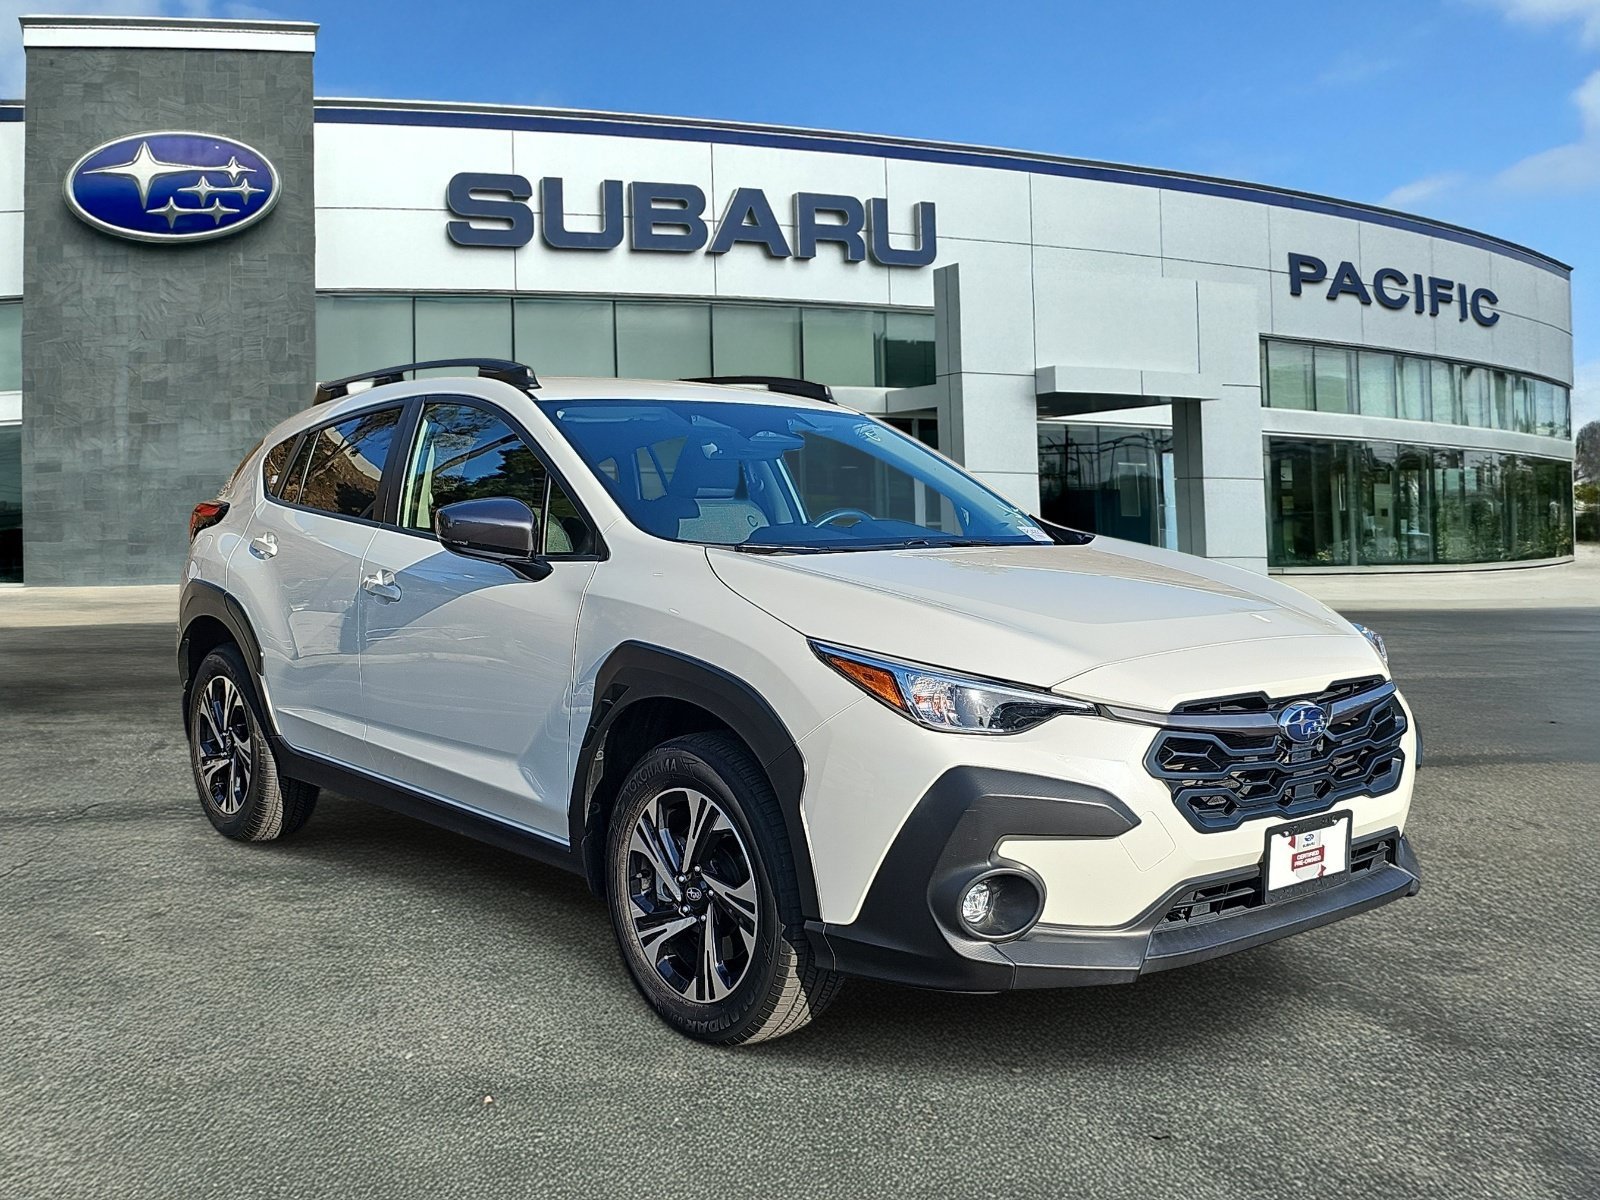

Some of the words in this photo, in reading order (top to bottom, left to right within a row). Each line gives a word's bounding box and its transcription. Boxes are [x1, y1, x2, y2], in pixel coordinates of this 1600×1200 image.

[446, 171, 937, 268] SUBARU
[1288, 252, 1500, 327] PACIFIC
[624, 758, 678, 797] YOKOHAMA
[1294, 855, 1322, 868] PRE-OWNED
[1296, 849, 1320, 861] CERTIFIED
